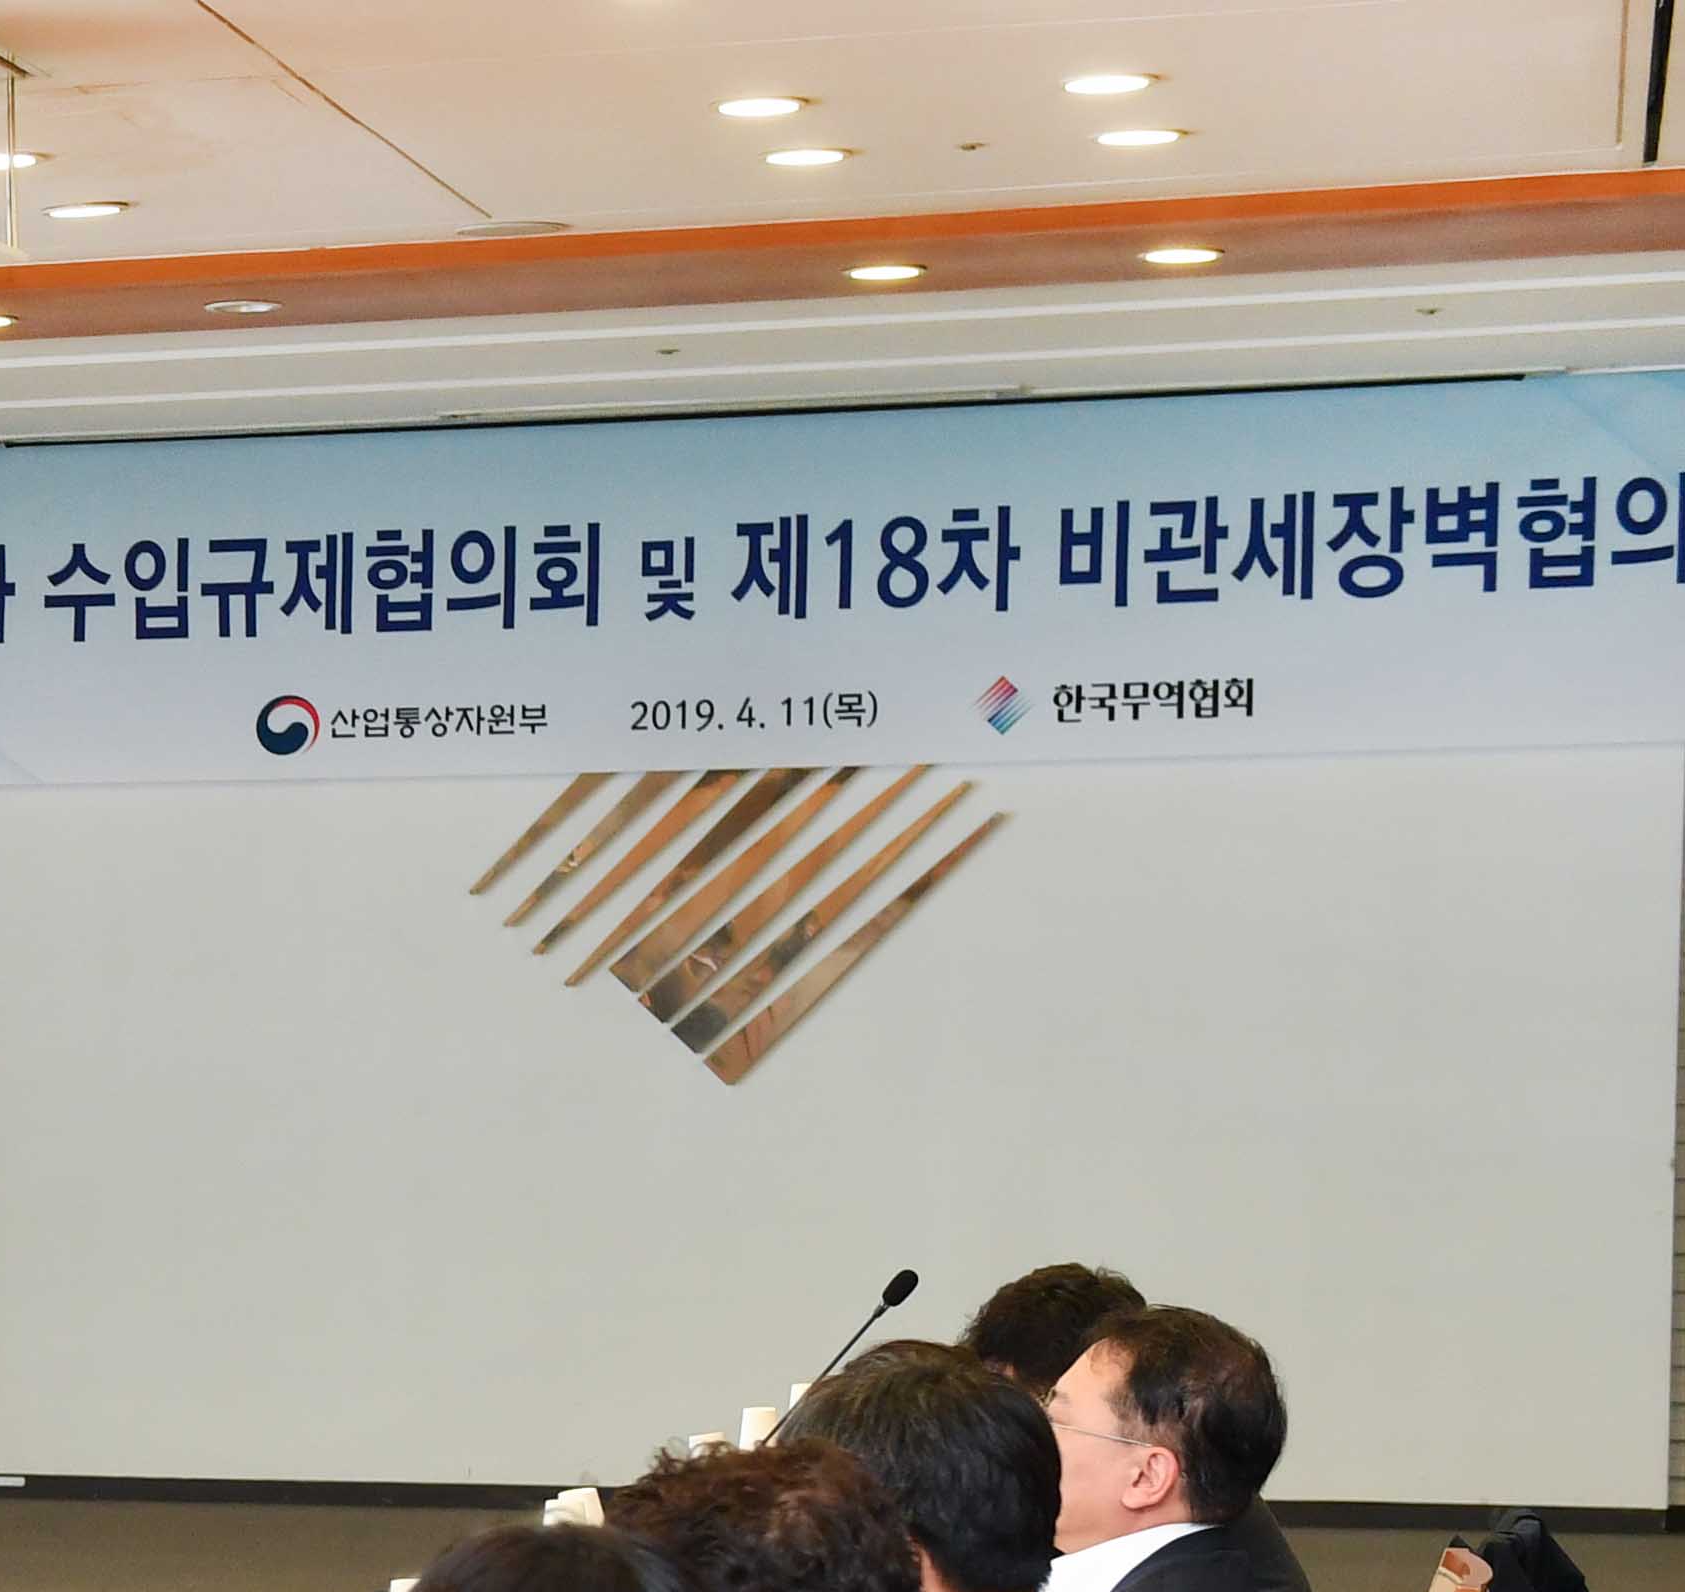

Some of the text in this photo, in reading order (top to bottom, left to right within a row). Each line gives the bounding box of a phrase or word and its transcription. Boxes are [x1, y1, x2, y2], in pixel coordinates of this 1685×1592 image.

[44, 522, 600, 642] 수입규제협의회
[642, 536, 695, 621] 및
[731, 505, 1021, 619] 제18차
[1059, 472, 1685, 608] 비관세장벽협의
[331, 704, 548, 738] 산업통상자원부
[631, 691, 877, 732] 2019. 4. 11(목)
[1053, 678, 1253, 723] 한국무역협회
